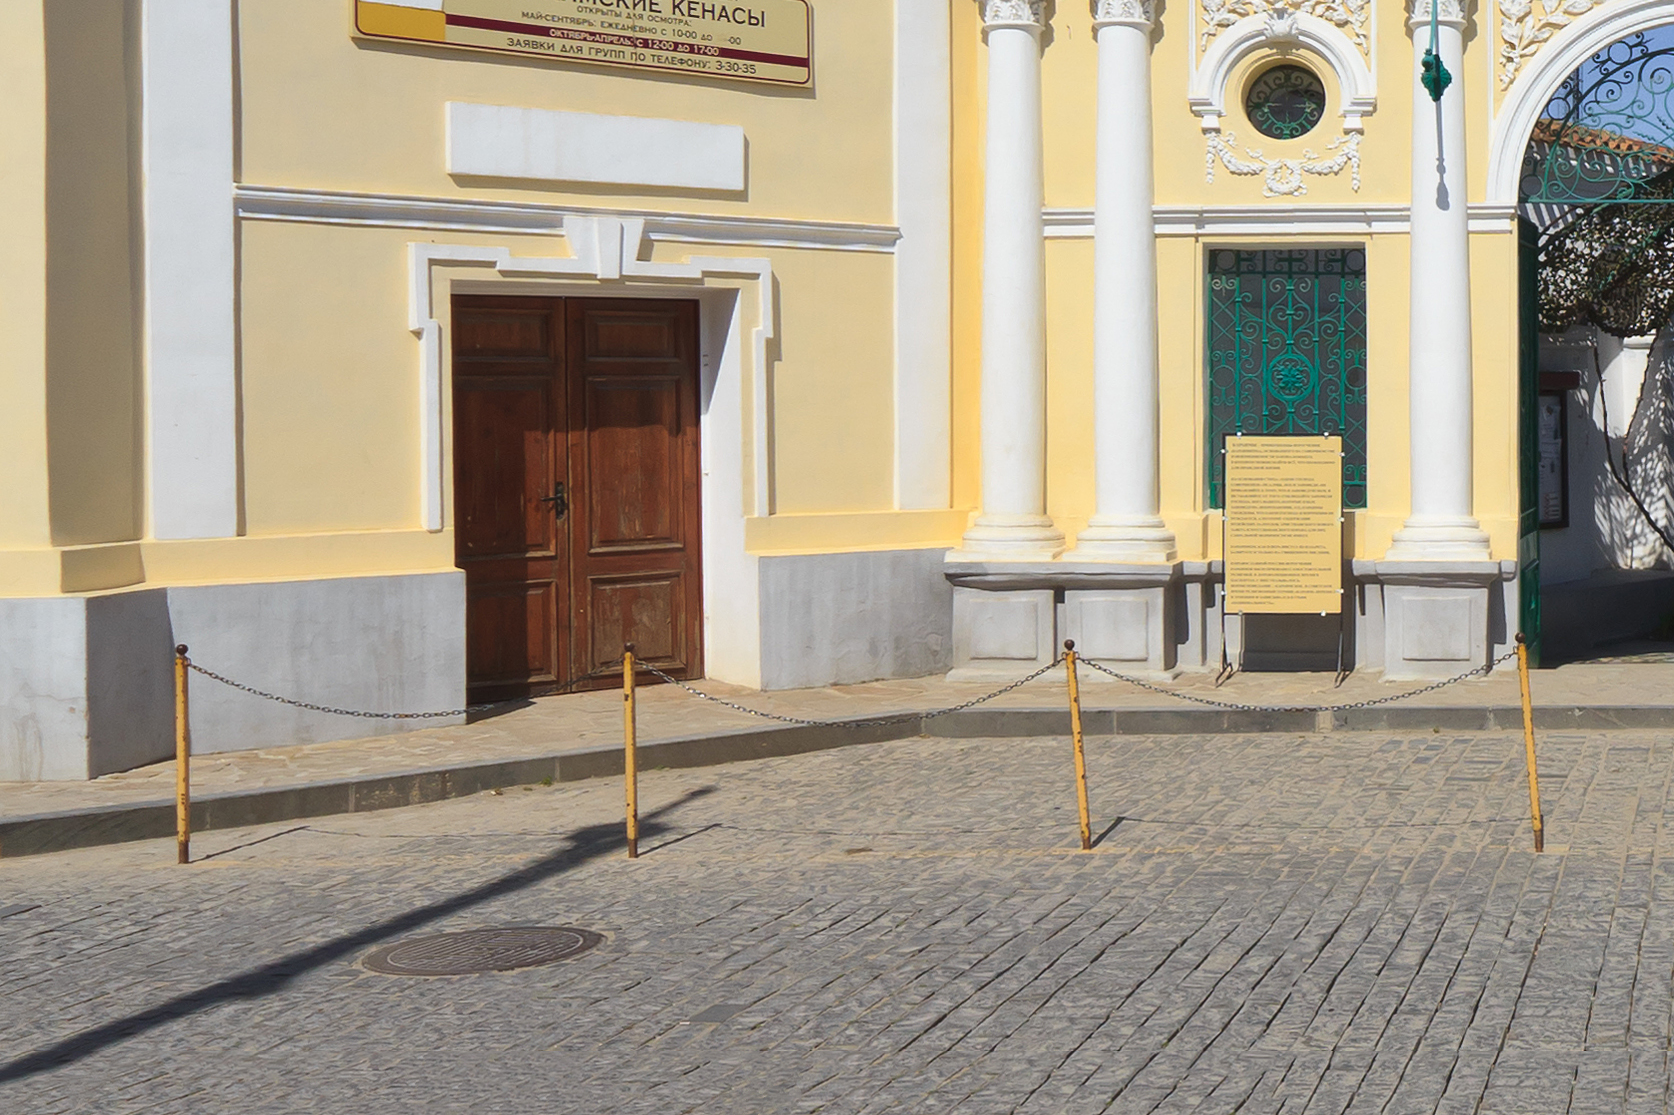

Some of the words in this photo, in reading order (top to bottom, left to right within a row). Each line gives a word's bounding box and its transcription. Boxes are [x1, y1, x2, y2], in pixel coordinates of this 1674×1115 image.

[521, 11, 596, 27] МАЙ-СЕНТЯБРЬ:
[601, 20, 657, 35] ЕЖЕДНЕВНО
[672, 28, 697, 40] 10-00
[701, 34, 712, 42] ДО
[577, 5, 622, 18] ОТКРЫТЫ
[625, 11, 643, 21] ДЛЯ
[647, 14, 692, 27] ОСМОТРА:
[507, 37, 555, 52] ЗАЯВКИ
[560, 44, 583, 55] ДЛЯ
[588, 46, 625, 59] ГРУПП
[630, 52, 646, 62] ПО
[650, 53, 710, 69] ТЕЛЕФОНУ:
[715, 60, 756, 75] 3-30-35
[549, 28, 635, 47] ОКТЯБРЬ-АПРЕЛЬ:
[648, 39, 674, 52] 12-00
[694, 45, 719, 56] 17-00
